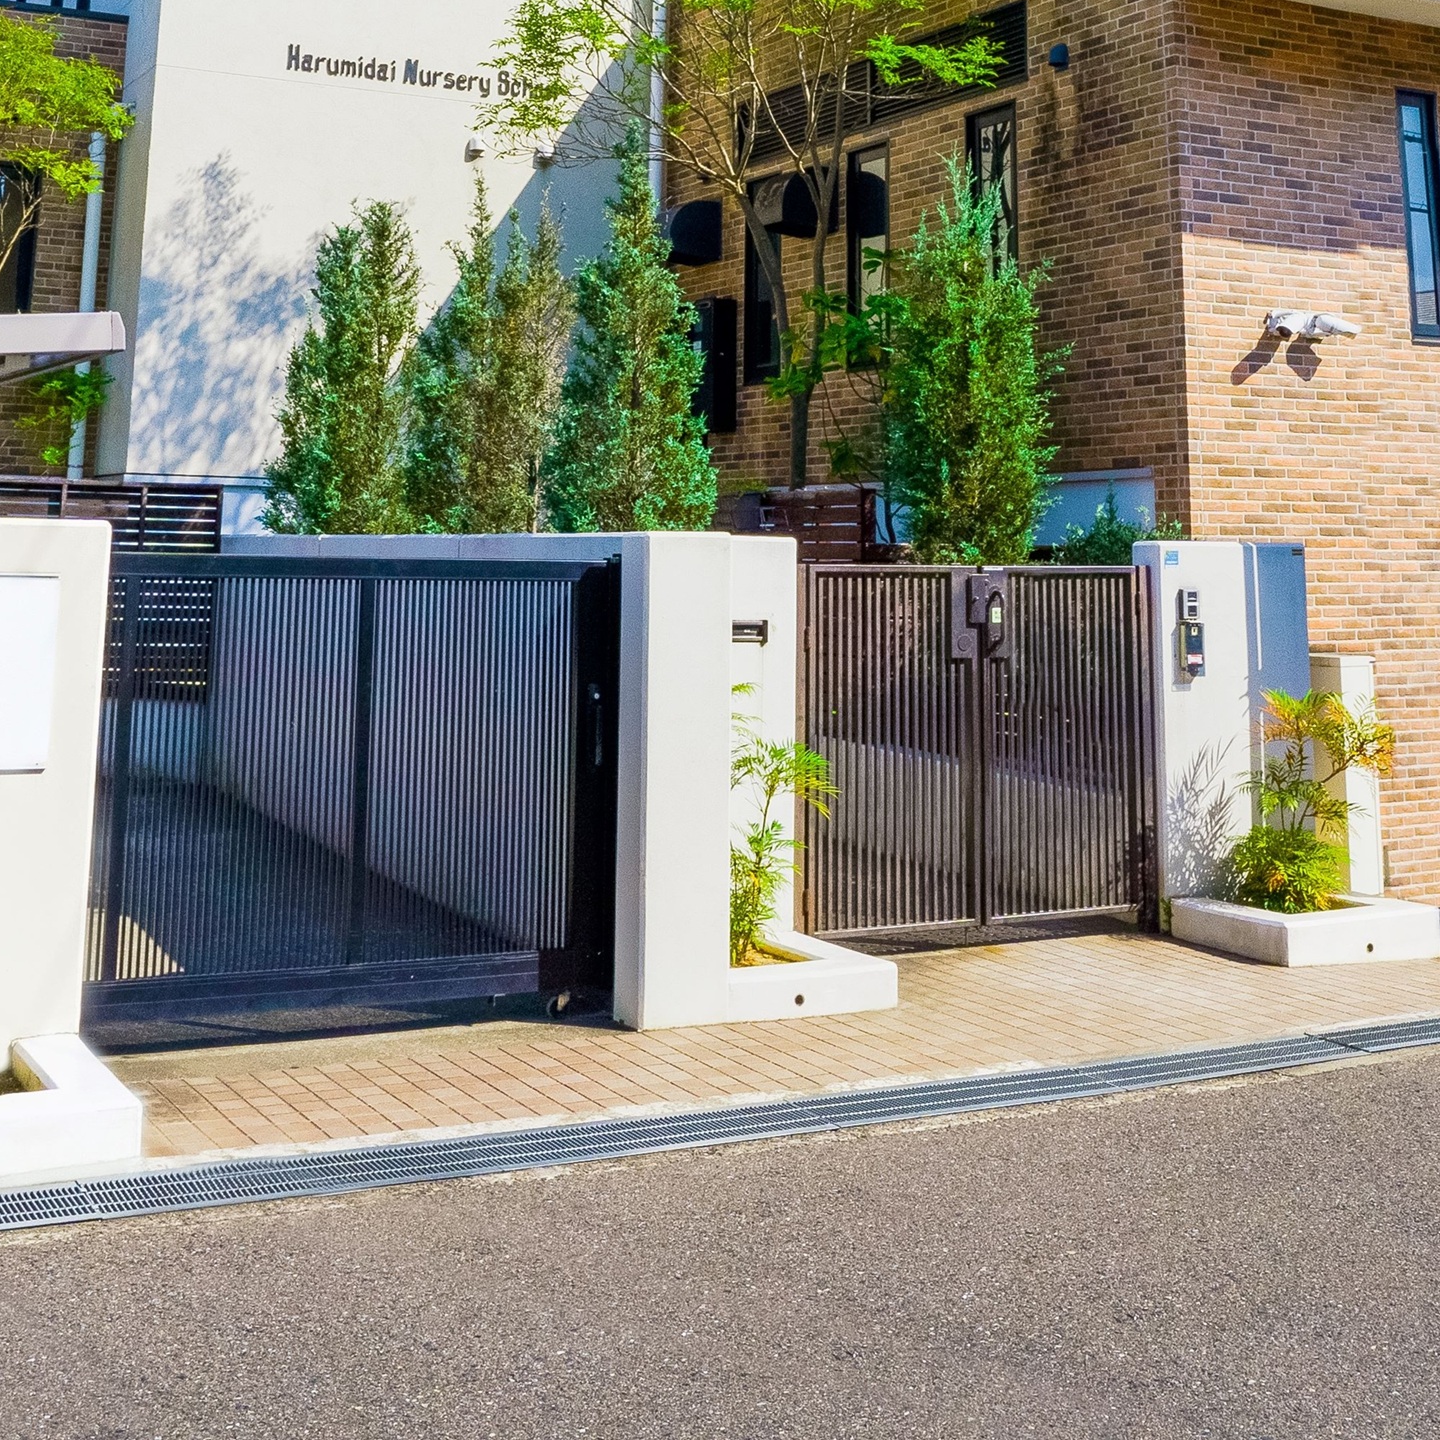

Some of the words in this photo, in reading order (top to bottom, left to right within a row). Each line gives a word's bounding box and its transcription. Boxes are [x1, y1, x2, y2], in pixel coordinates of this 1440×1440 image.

[286, 44, 396, 82] Harumidai
[402, 59, 491, 98] Nursery
[497, 70, 553, 101] Sch
